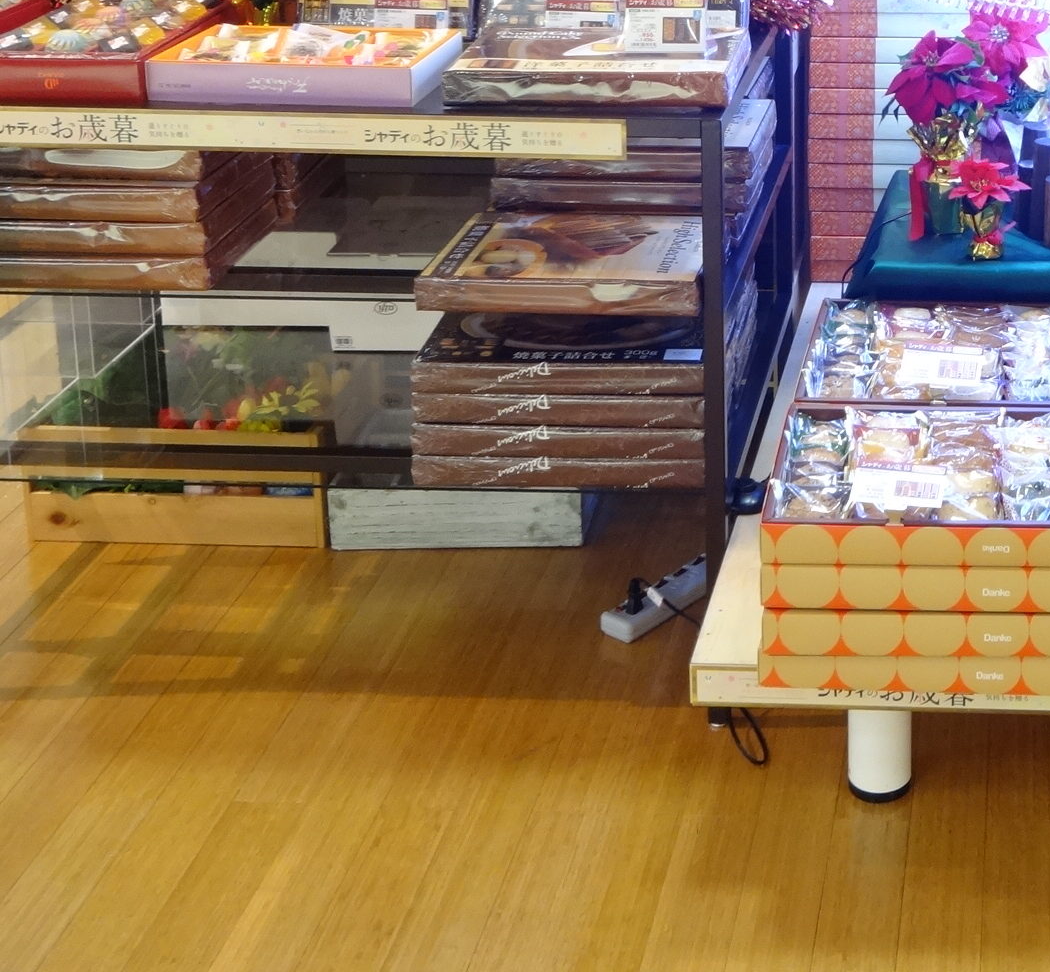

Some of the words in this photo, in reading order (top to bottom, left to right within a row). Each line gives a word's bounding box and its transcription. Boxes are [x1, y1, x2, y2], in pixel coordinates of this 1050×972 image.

[364, 122, 512, 152] シャディのお歳暮
[656, 238, 692, 274] Selection
[982, 588, 1011, 597] Danke
[984, 633, 1012, 642] Danke
[976, 671, 1004, 681] Danke
